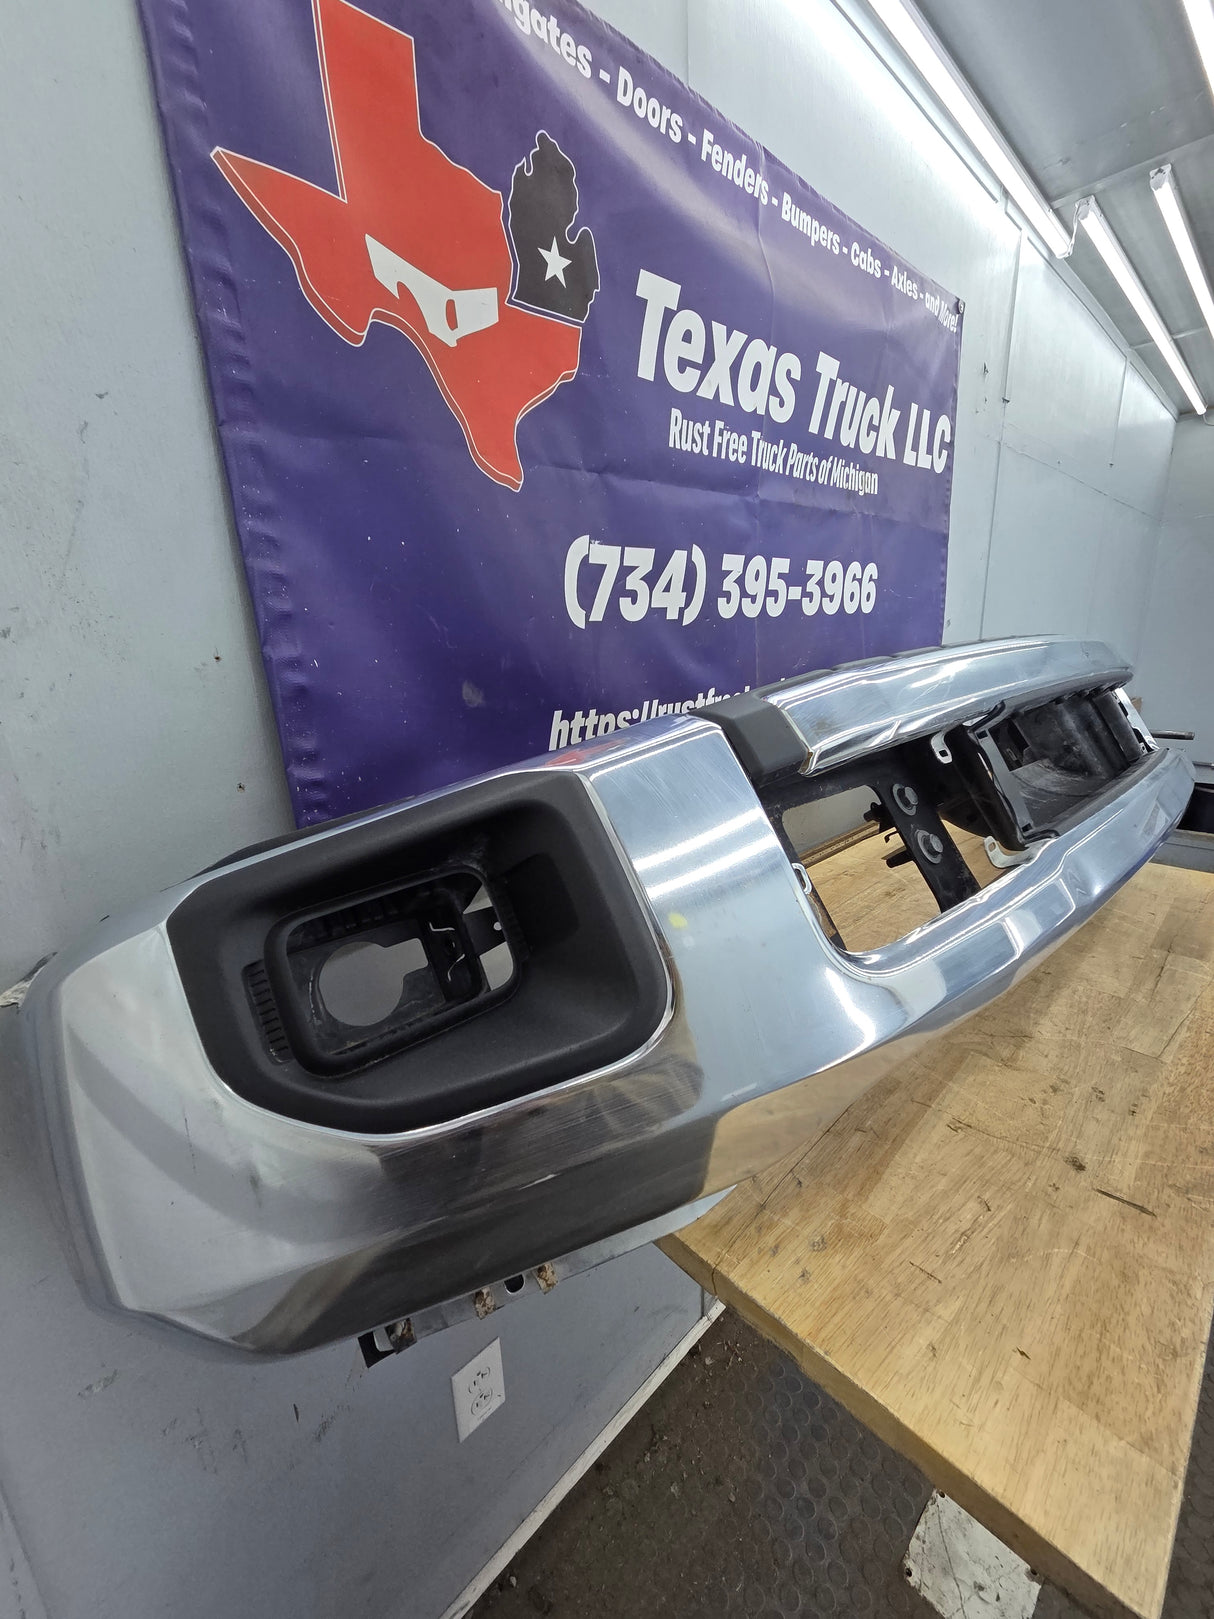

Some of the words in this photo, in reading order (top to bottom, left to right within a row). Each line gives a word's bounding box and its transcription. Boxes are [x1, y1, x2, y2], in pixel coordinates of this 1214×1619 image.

[504, 0, 592, 79] gates
[616, 66, 683, 143] Doors
[701, 128, 769, 206] Fenders
[781, 192, 841, 255] Bumpers
[851, 242, 882, 279] Cabs
[891, 266, 918, 301] Axles
[925, 292, 940, 317] and
[636, 269, 801, 423] Texas
[809, 351, 901, 460] Truck
[903, 403, 951, 474] LLC
[669, 408, 710, 456] Rust
[712, 420, 747, 464] Free
[751, 431, 786, 475] Truck
[786, 443, 817, 483] Parts
[818, 455, 832, 485] of
[832, 457, 879, 496] Michigan
[564, 534, 707, 629] (734)
[717, 553, 878, 619] 395-3966
